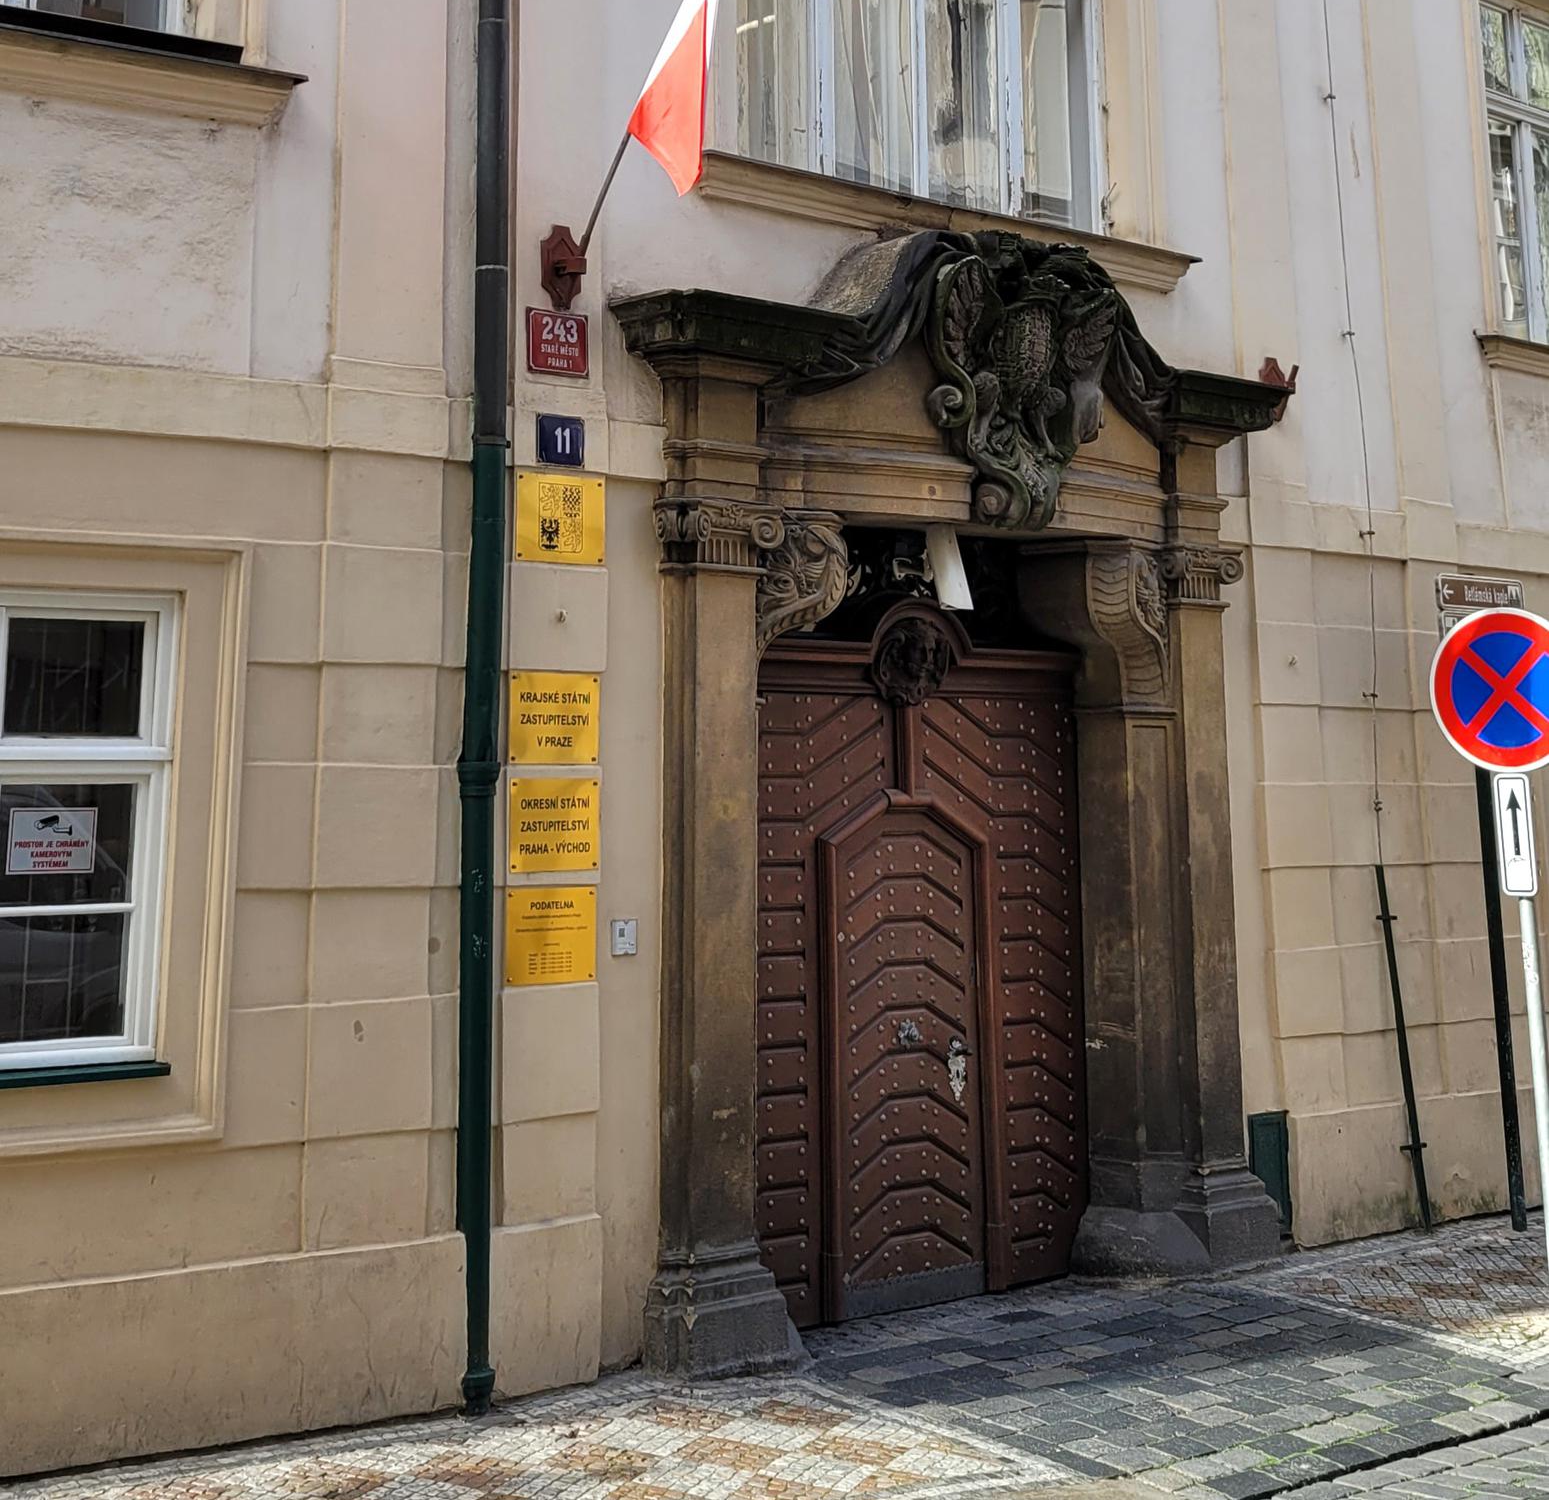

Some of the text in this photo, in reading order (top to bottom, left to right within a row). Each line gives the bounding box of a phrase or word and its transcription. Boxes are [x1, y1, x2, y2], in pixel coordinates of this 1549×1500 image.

[542, 316, 578, 343] 243
[541, 343, 579, 357] STARÉ MĚSTO
[547, 357, 567, 368] PRAHA
[554, 426, 570, 454] 11
[520, 690, 591, 704] KRAJSKÉ STÁTNÍ
[520, 713, 589, 726] ZASTUPITELSTVÍ
[537, 735, 572, 747] V PRAZE
[521, 796, 590, 810] OKRESNÍ STÁTNÍ
[521, 817, 590, 832] ZASTUPITELSTVÍ
[14, 840, 43, 848] PROSTOR
[46, 840, 53, 848] JE
[520, 843, 549, 855] PRAHA
[556, 840, 591, 854] VÝCHOD
[530, 900, 574, 910] PODATELNA
